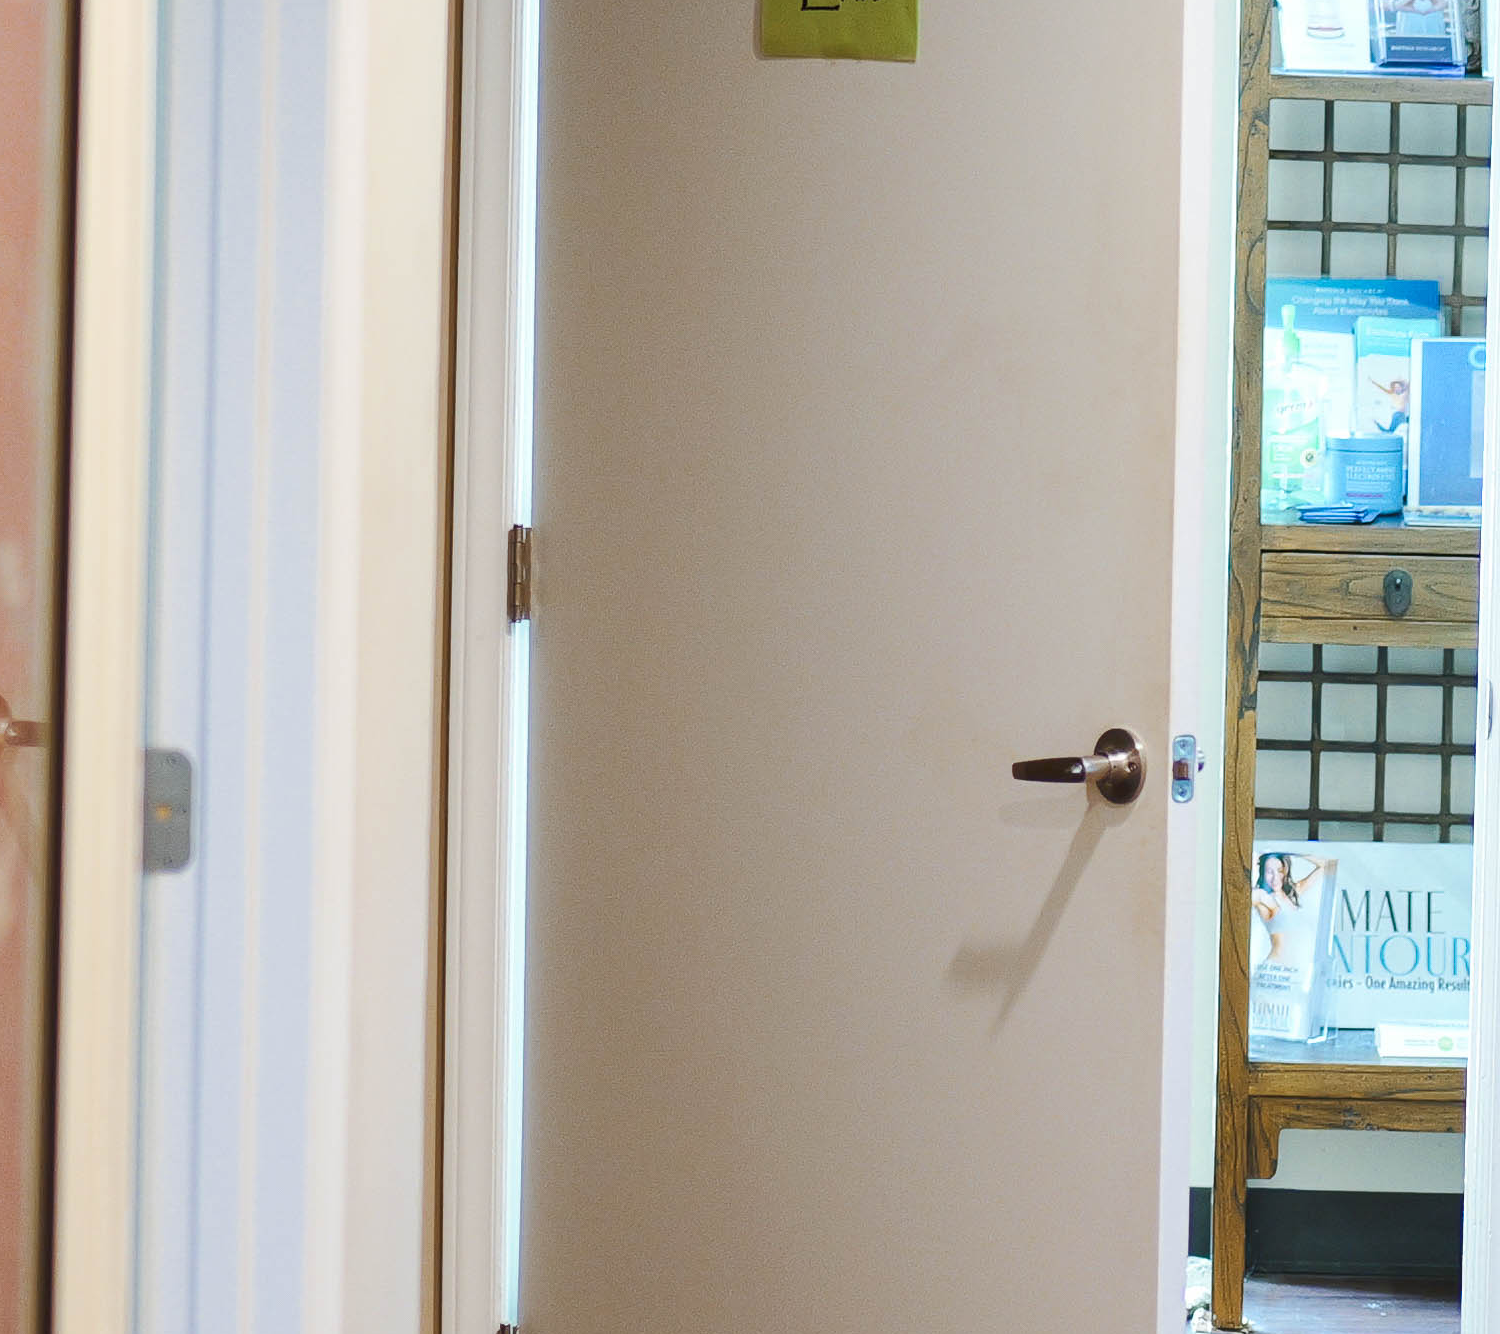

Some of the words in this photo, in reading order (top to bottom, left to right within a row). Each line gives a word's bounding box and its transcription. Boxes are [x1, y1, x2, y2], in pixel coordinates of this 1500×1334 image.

[1341, 889, 1446, 934] MATE
[1333, 934, 1470, 977] NTOUR
[1365, 975, 1386, 989] One
[1389, 975, 1435, 993] Amazing
